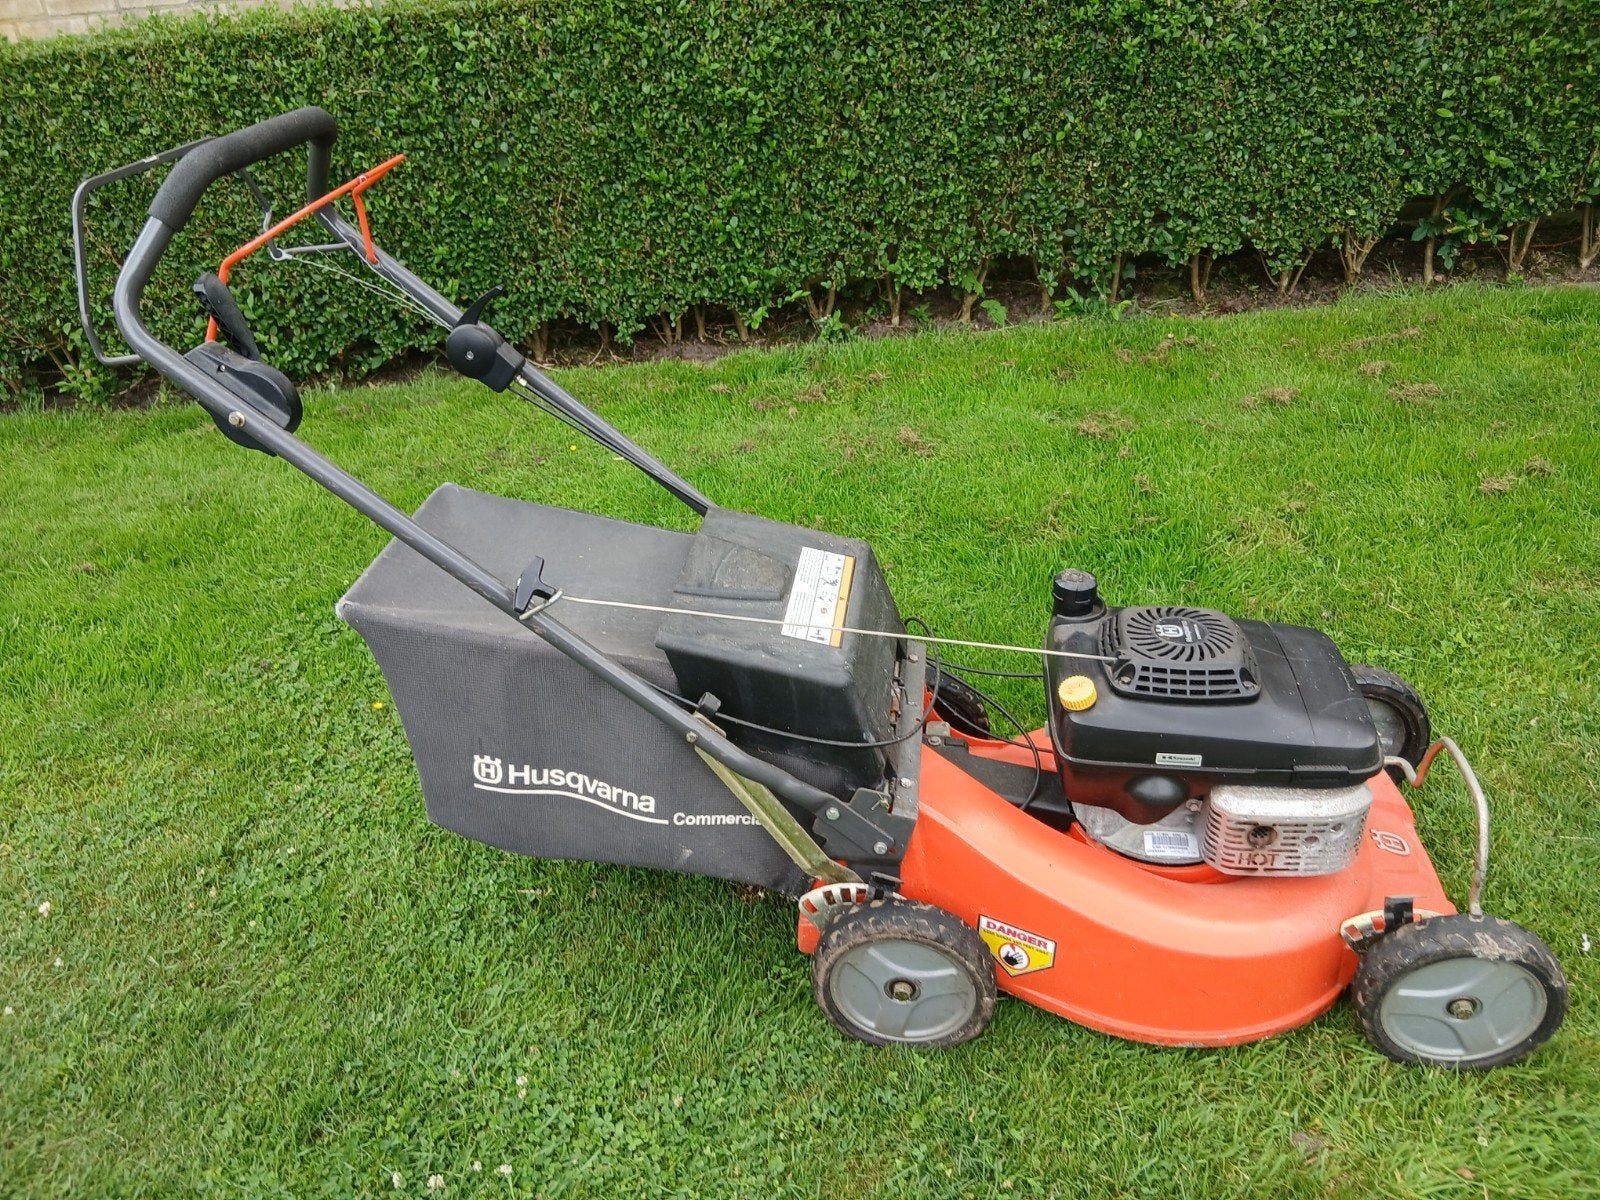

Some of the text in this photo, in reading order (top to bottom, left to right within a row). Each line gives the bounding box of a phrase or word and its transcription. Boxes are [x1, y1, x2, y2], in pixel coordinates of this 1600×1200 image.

[508, 764, 656, 813] Husqvarna
[1238, 853, 1279, 866] HOT
[986, 921, 1048, 949] DANGER
